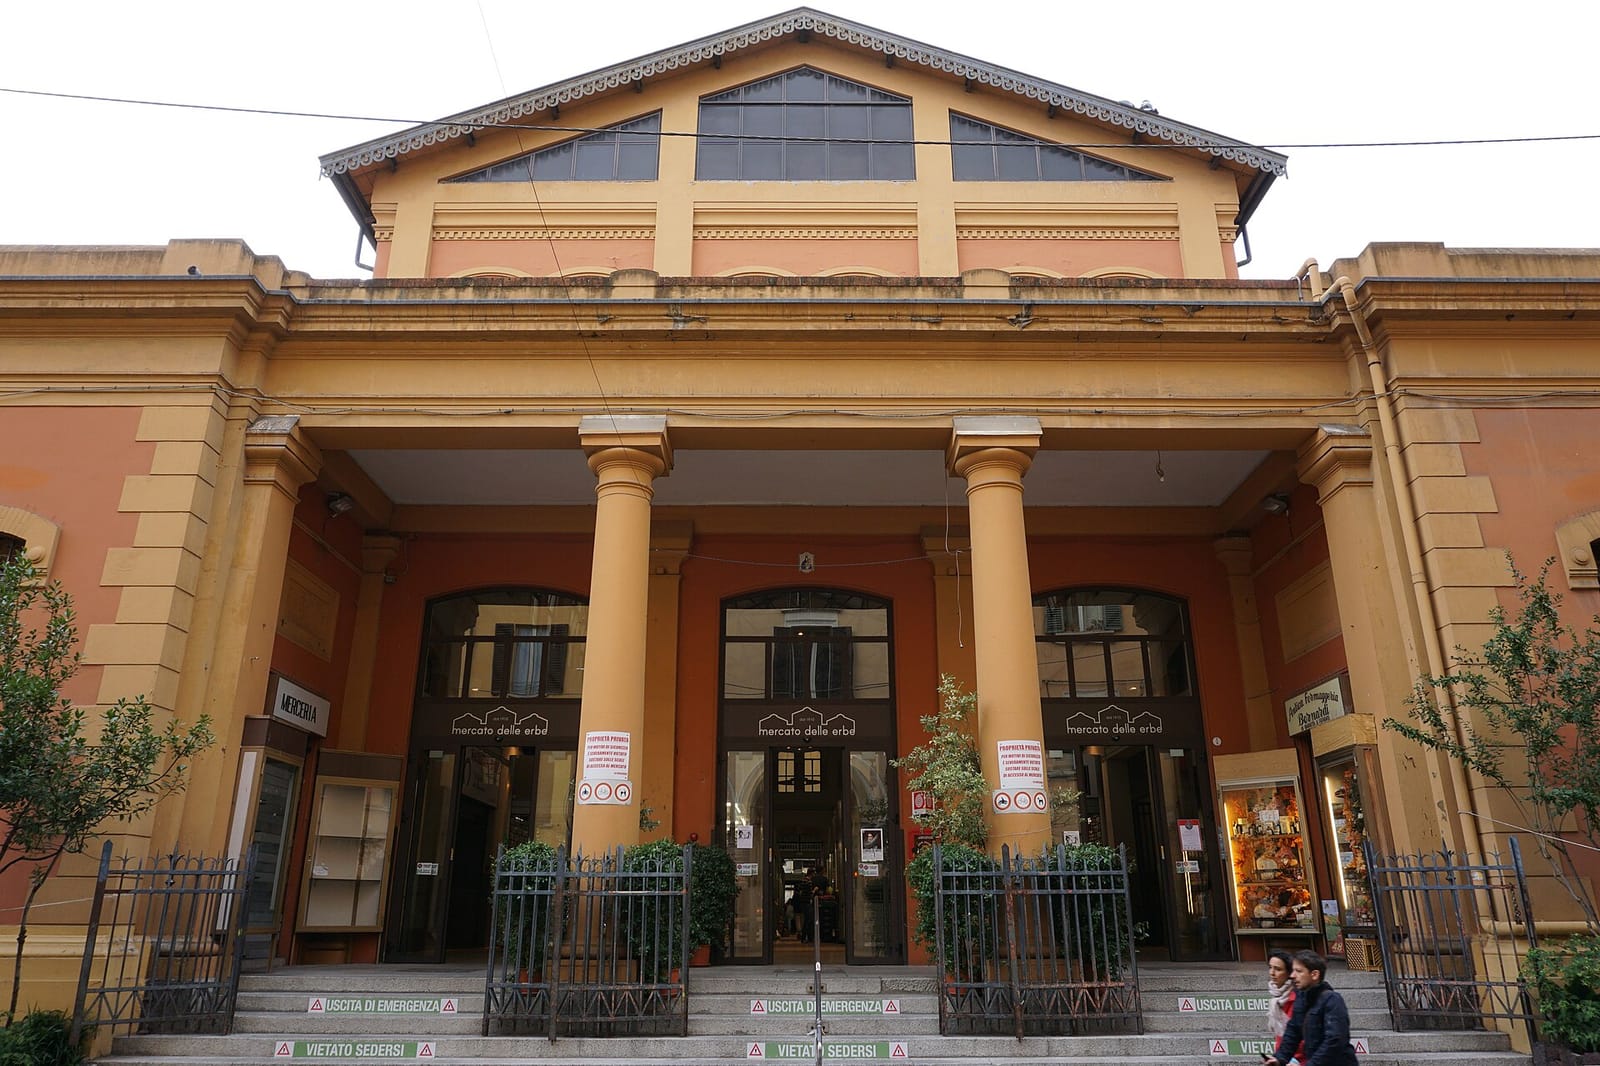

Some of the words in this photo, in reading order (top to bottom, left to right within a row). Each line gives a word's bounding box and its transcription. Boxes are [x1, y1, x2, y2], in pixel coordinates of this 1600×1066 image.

[281, 693, 316, 723] MERCERIA
[1298, 703, 1329, 726] Bernardi
[452, 727, 494, 735] mercato
[497, 724, 521, 735] delle
[524, 724, 548, 735] erbe
[759, 728, 801, 736] mercato
[804, 725, 828, 736] delle
[832, 725, 855, 736] erbe
[1067, 726, 1109, 734] mercato
[1112, 723, 1136, 734] delle
[1140, 723, 1162, 734] erbe
[326, 1000, 361, 1012] USCITA
[364, 1000, 375, 1012] DI
[377, 1000, 440, 1012] EMERGENZA
[768, 1001, 803, 1012] USCITA
[821, 1001, 882, 1012] EMERGENZA
[1196, 999, 1233, 1010] USCITA
[1235, 999, 1245, 1010] DI
[306, 1043, 353, 1056] VIETATO
[355, 1044, 404, 1056] SEDERSI
[828, 1045, 876, 1057] SEDERSI
[1240, 1041, 1277, 1053] VIETAT
